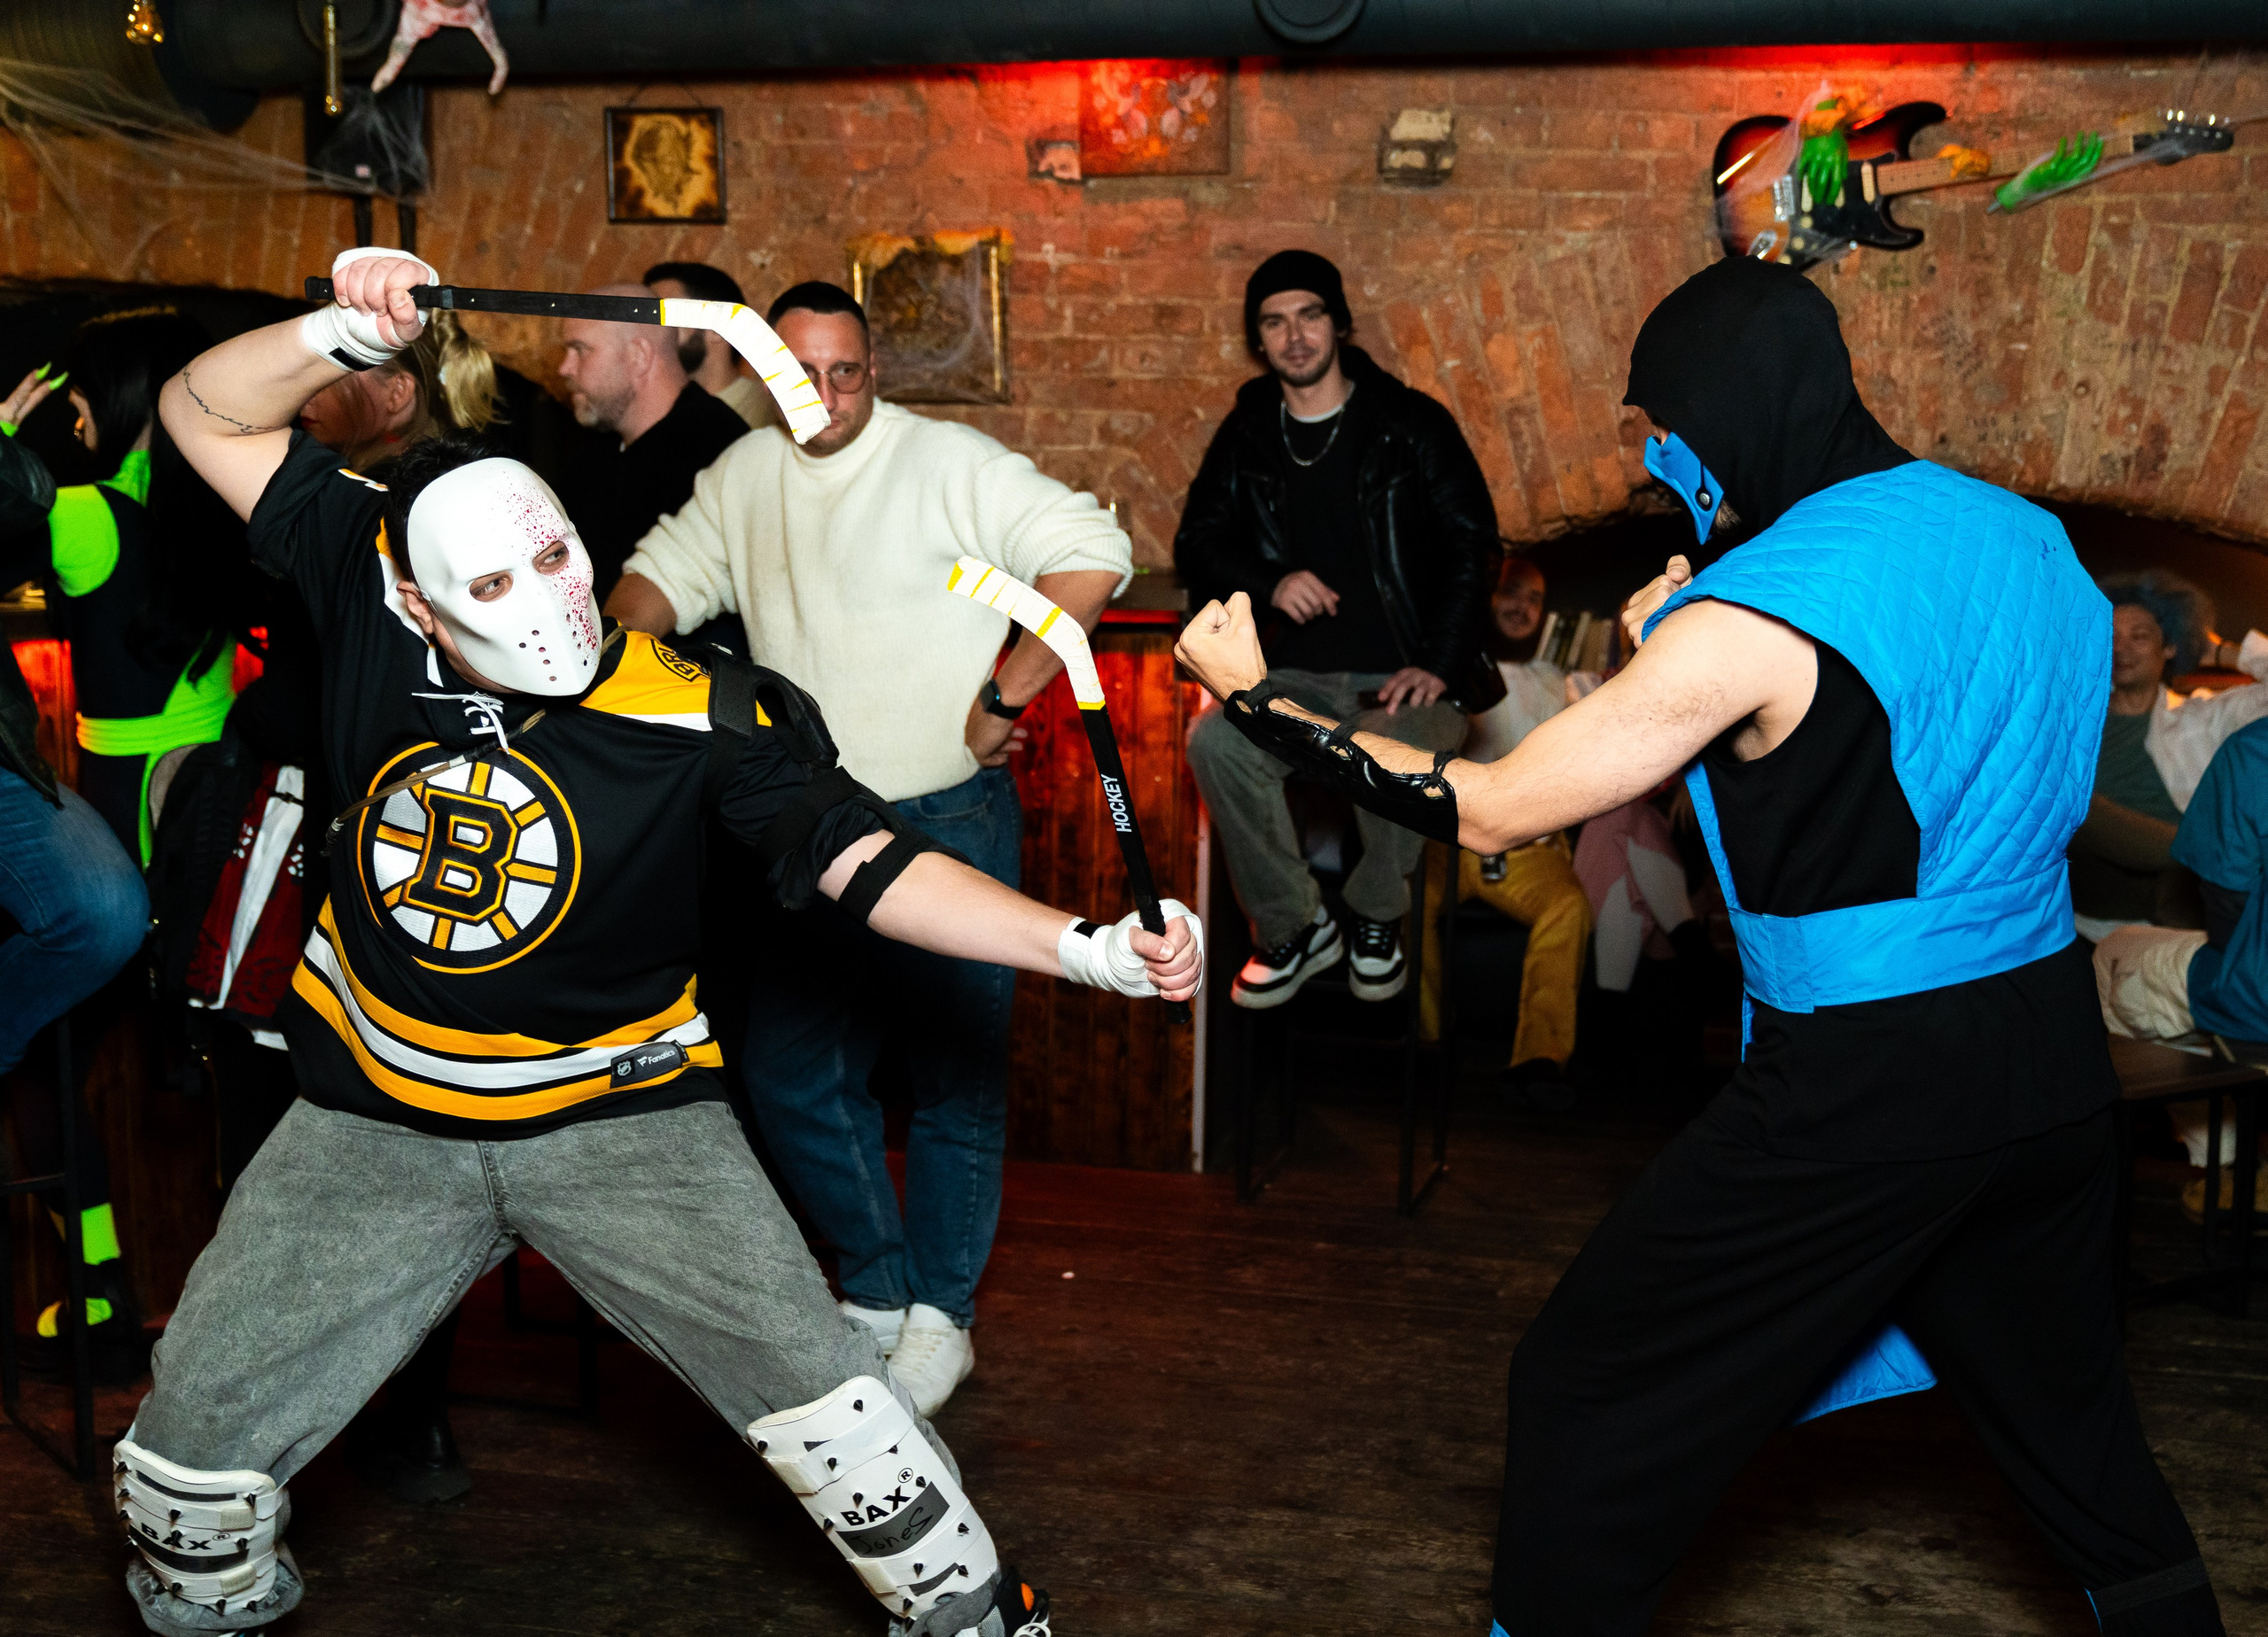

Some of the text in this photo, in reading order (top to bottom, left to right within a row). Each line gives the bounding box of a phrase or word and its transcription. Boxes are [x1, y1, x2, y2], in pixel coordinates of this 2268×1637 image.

[1100, 773, 1132, 833] HOCKEY
[402, 787, 518, 921] B
[648, 1049, 676, 1065] Fanatics
